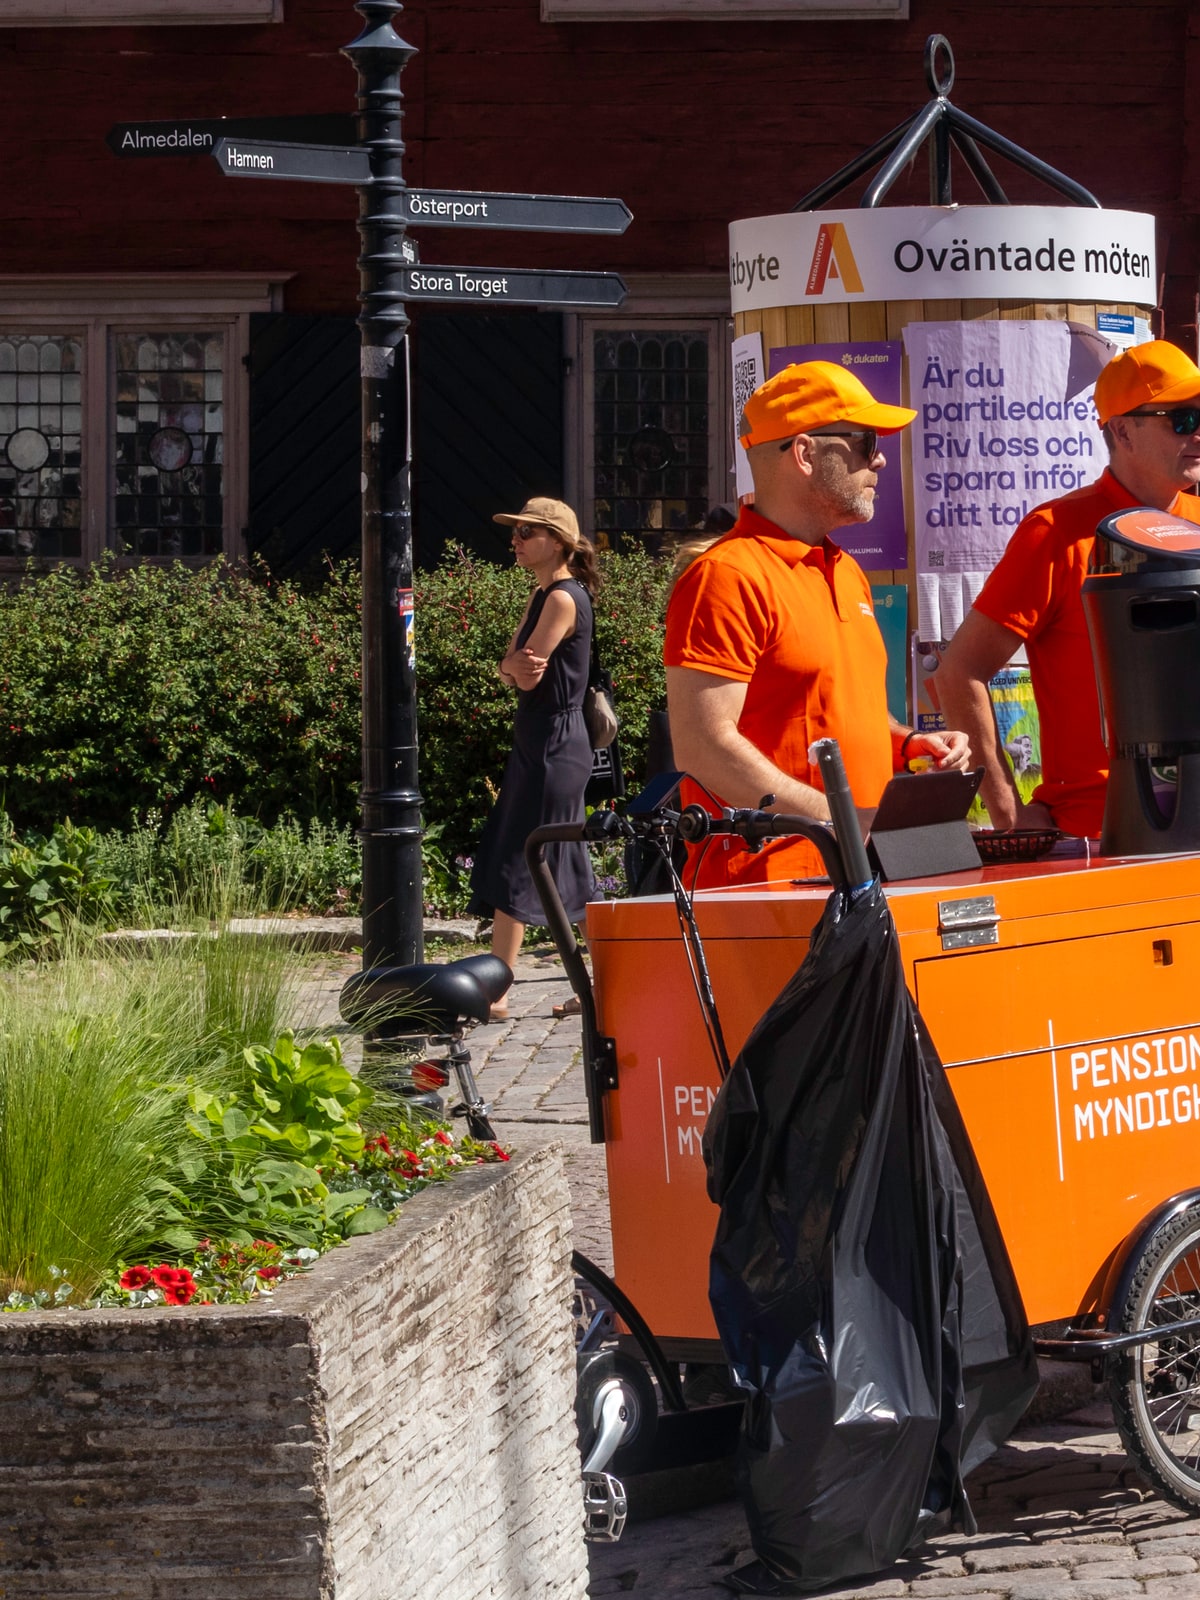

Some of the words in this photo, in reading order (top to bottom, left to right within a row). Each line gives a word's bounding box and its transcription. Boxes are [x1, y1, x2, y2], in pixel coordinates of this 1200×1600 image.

[121, 128, 213, 148] Almedalen
[227, 147, 274, 169] Hamnen
[409, 195, 488, 221] Österport
[894, 238, 1076, 273] Oväntade
[1085, 242, 1150, 278] möten
[410, 272, 453, 292] Stora
[455, 273, 508, 297] Torget
[853, 353, 889, 364] dukaten
[922, 356, 960, 389] Är
[965, 362, 1004, 388] du
[922, 395, 1098, 429] partiledare?
[924, 432, 971, 459] Riv
[978, 432, 1039, 457] loss
[1045, 431, 1093, 457] och
[925, 469, 1016, 498] spara
[1024, 463, 1086, 490] inför
[926, 501, 982, 528] ditt
[988, 500, 1028, 526] tal
